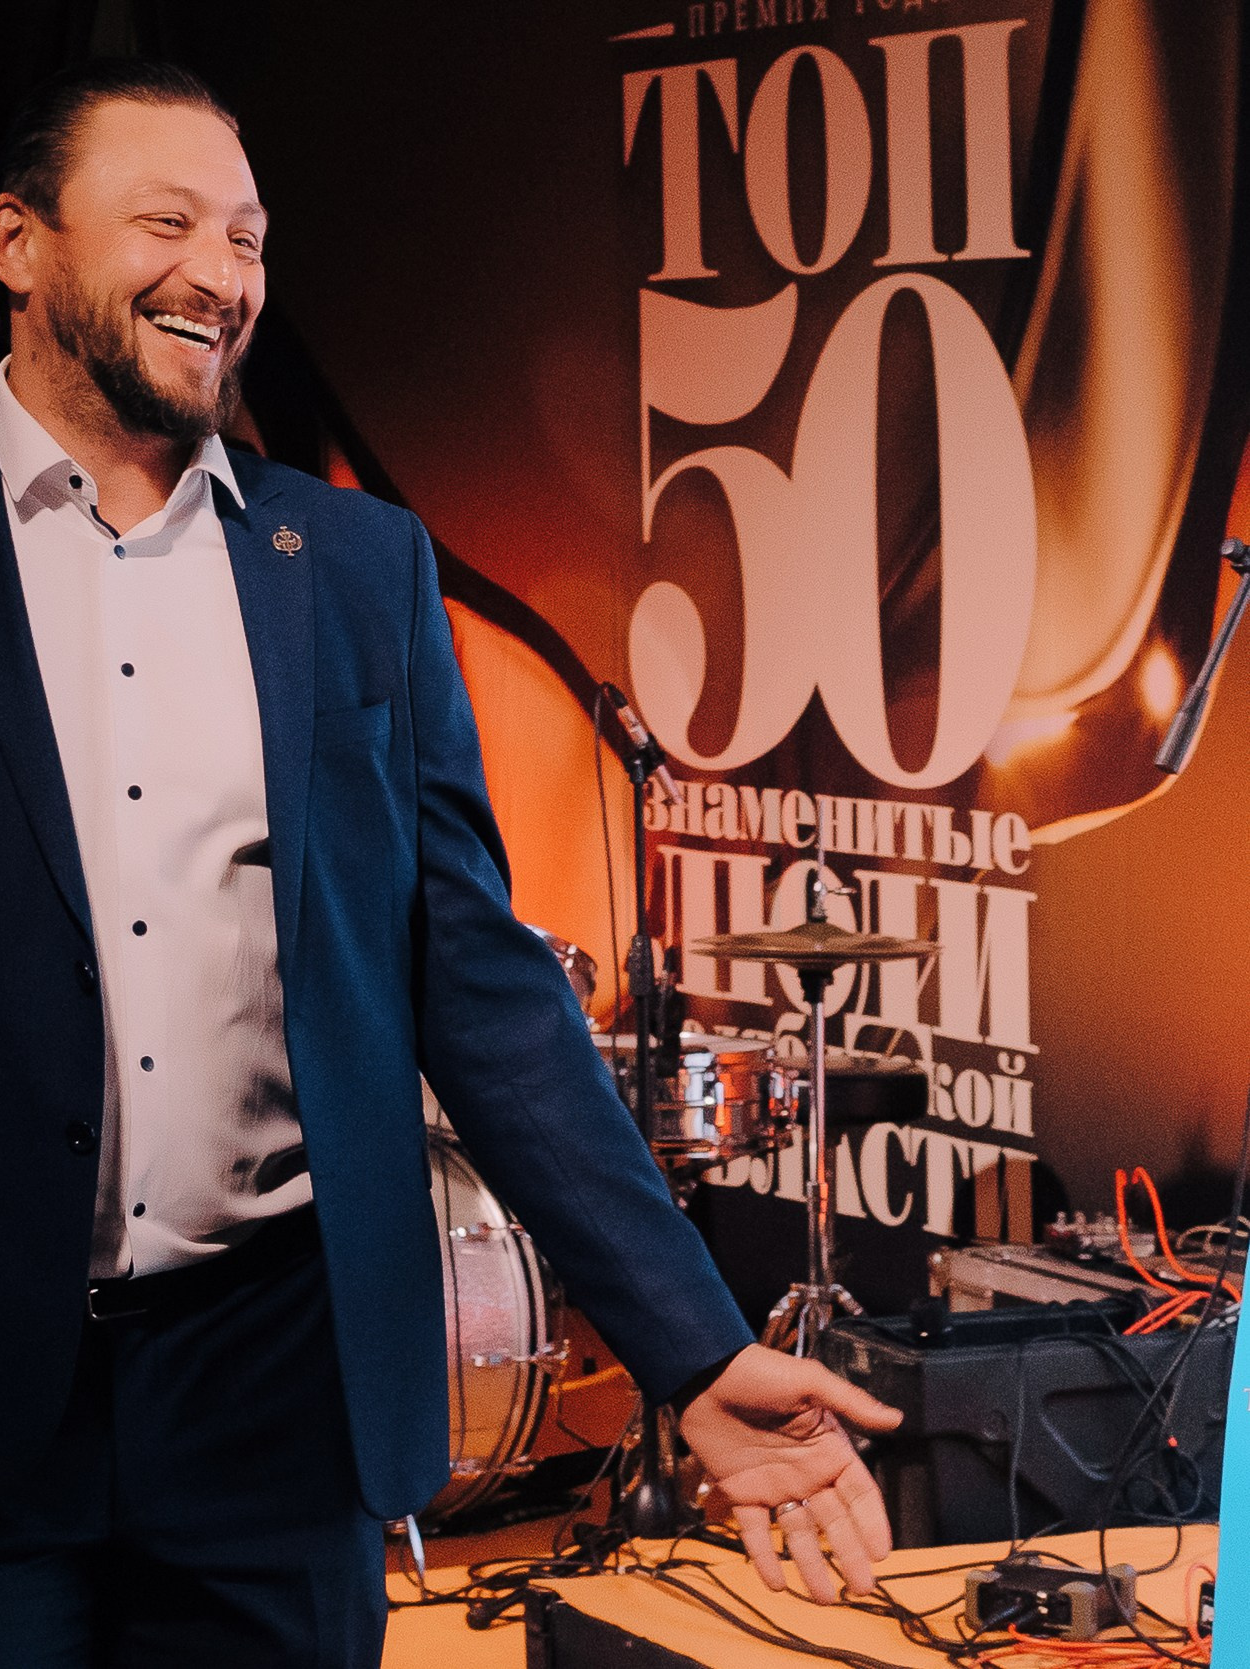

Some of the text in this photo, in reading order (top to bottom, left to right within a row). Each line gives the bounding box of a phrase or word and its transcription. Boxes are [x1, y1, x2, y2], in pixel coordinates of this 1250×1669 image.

[622, 19, 1032, 282] ТОП
[627, 271, 1039, 791] 50
[643, 776, 1033, 876] знаменитые
[650, 844, 1039, 1070] ЛЮДИ
